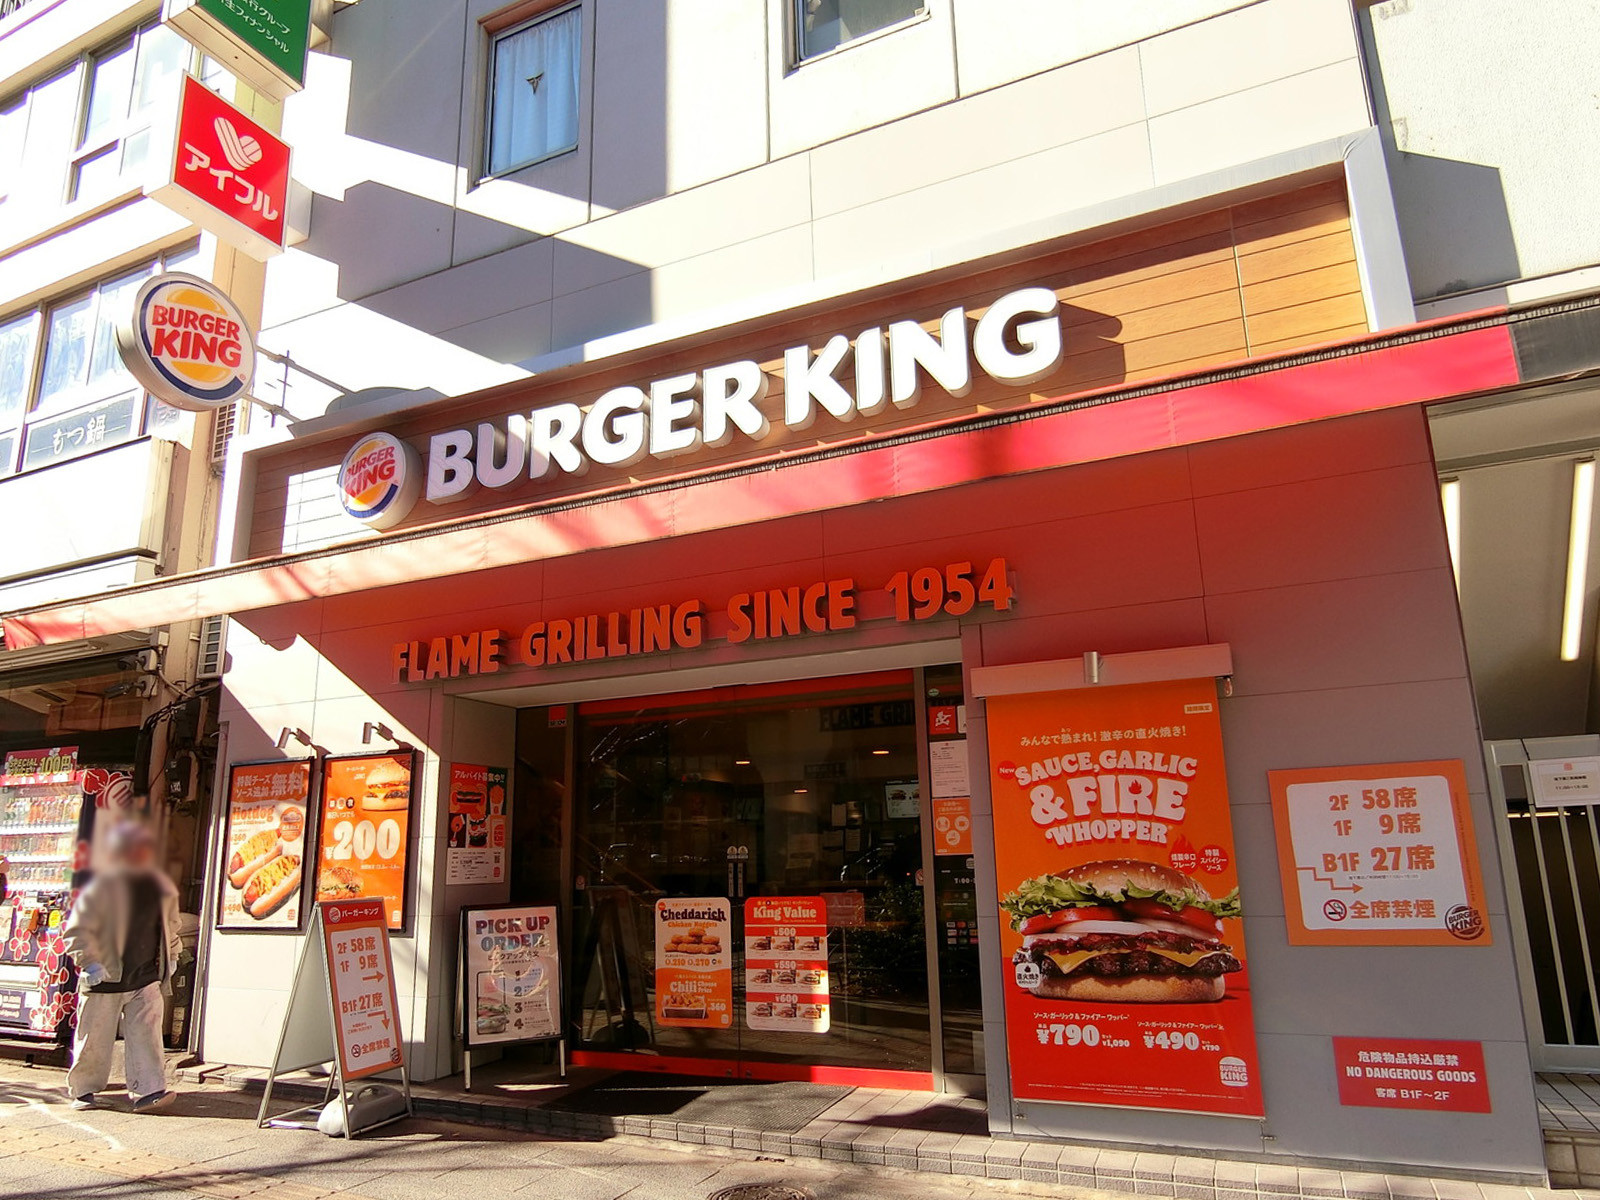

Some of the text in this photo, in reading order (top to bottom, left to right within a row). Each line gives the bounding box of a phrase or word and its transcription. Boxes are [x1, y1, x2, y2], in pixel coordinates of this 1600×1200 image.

[220, 0, 289, 53] 生フィナンシャル
[243, 0, 290, 33] 行グループ
[184, 142, 279, 221] アイフル
[152, 304, 240, 340] BURGER
[152, 328, 242, 368] KING
[427, 287, 1061, 501] BURGER KING
[346, 446, 394, 477] BURGER
[345, 459, 396, 498] KING
[392, 557, 1013, 685] FLAME GRILLING SINCE 1954
[1000, 766, 1015, 775] New
[1015, 750, 1197, 786] SAUCE, GARLIC
[1029, 774, 1189, 824] & FIRE
[1328, 786, 1417, 811] 2F 58席
[231, 804, 275, 823] Hotdog
[1045, 818, 1168, 846] WHOPPER
[1333, 812, 1421, 836] 1F 9席
[1173, 861, 1196, 869] フレーク
[1322, 844, 1435, 873] B1F 27席
[342, 907, 379, 918] バーガーキング
[660, 907, 727, 922] Cheddarich
[753, 906, 817, 921] King Value
[1350, 899, 1436, 919] 全席禁煙
[1448, 909, 1479, 924] BURGER
[475, 915, 550, 935] PICK UP
[1451, 917, 1483, 933] KING
[337, 936, 376, 955] 2F 58席
[340, 953, 378, 973] 1F 9席
[514, 986, 522, 997] 2
[670, 980, 697, 993] Chili
[341, 992, 384, 1014] B1F 27席
[514, 1002, 522, 1013] 3
[514, 1018, 524, 1030] 4
[1036, 1023, 1100, 1047] ¥790
[1102, 1039, 1130, 1048] ¥1,090
[1143, 1030, 1199, 1051] ¥490
[361, 1037, 391, 1055] 全席禁煙
[1202, 1044, 1220, 1052] ¥790
[1357, 1050, 1459, 1067] 危険物品持込厳禁
[1220, 1071, 1248, 1081] KING
[1346, 1066, 1476, 1083] NO DANGEROUS GOODS
[1375, 1087, 1396, 1099] 客席
